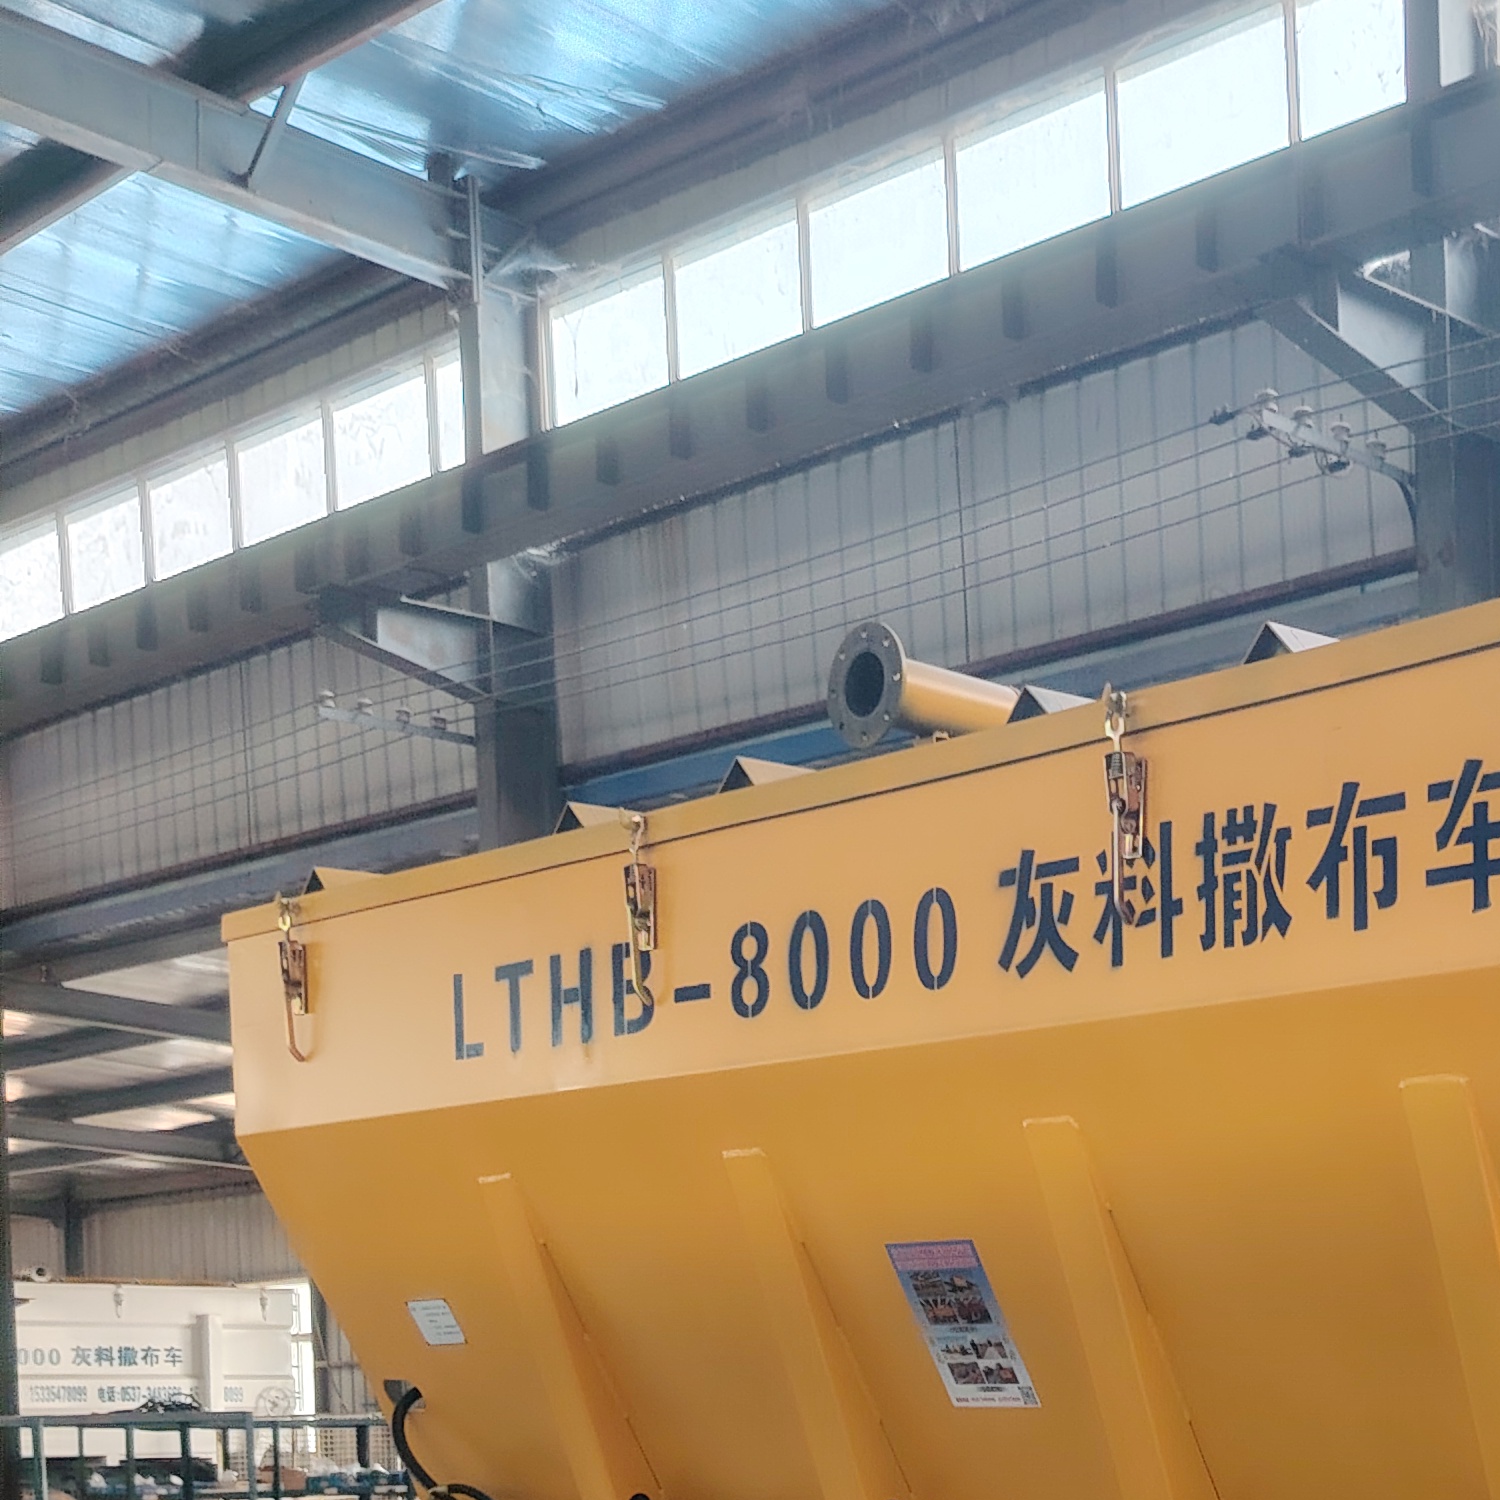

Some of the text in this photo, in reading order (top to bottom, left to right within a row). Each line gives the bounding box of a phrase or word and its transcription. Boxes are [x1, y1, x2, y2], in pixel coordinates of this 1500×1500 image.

[453, 886, 958, 1060] LTHB-8000
[71, 1345, 184, 1367] 灰料撒布车
